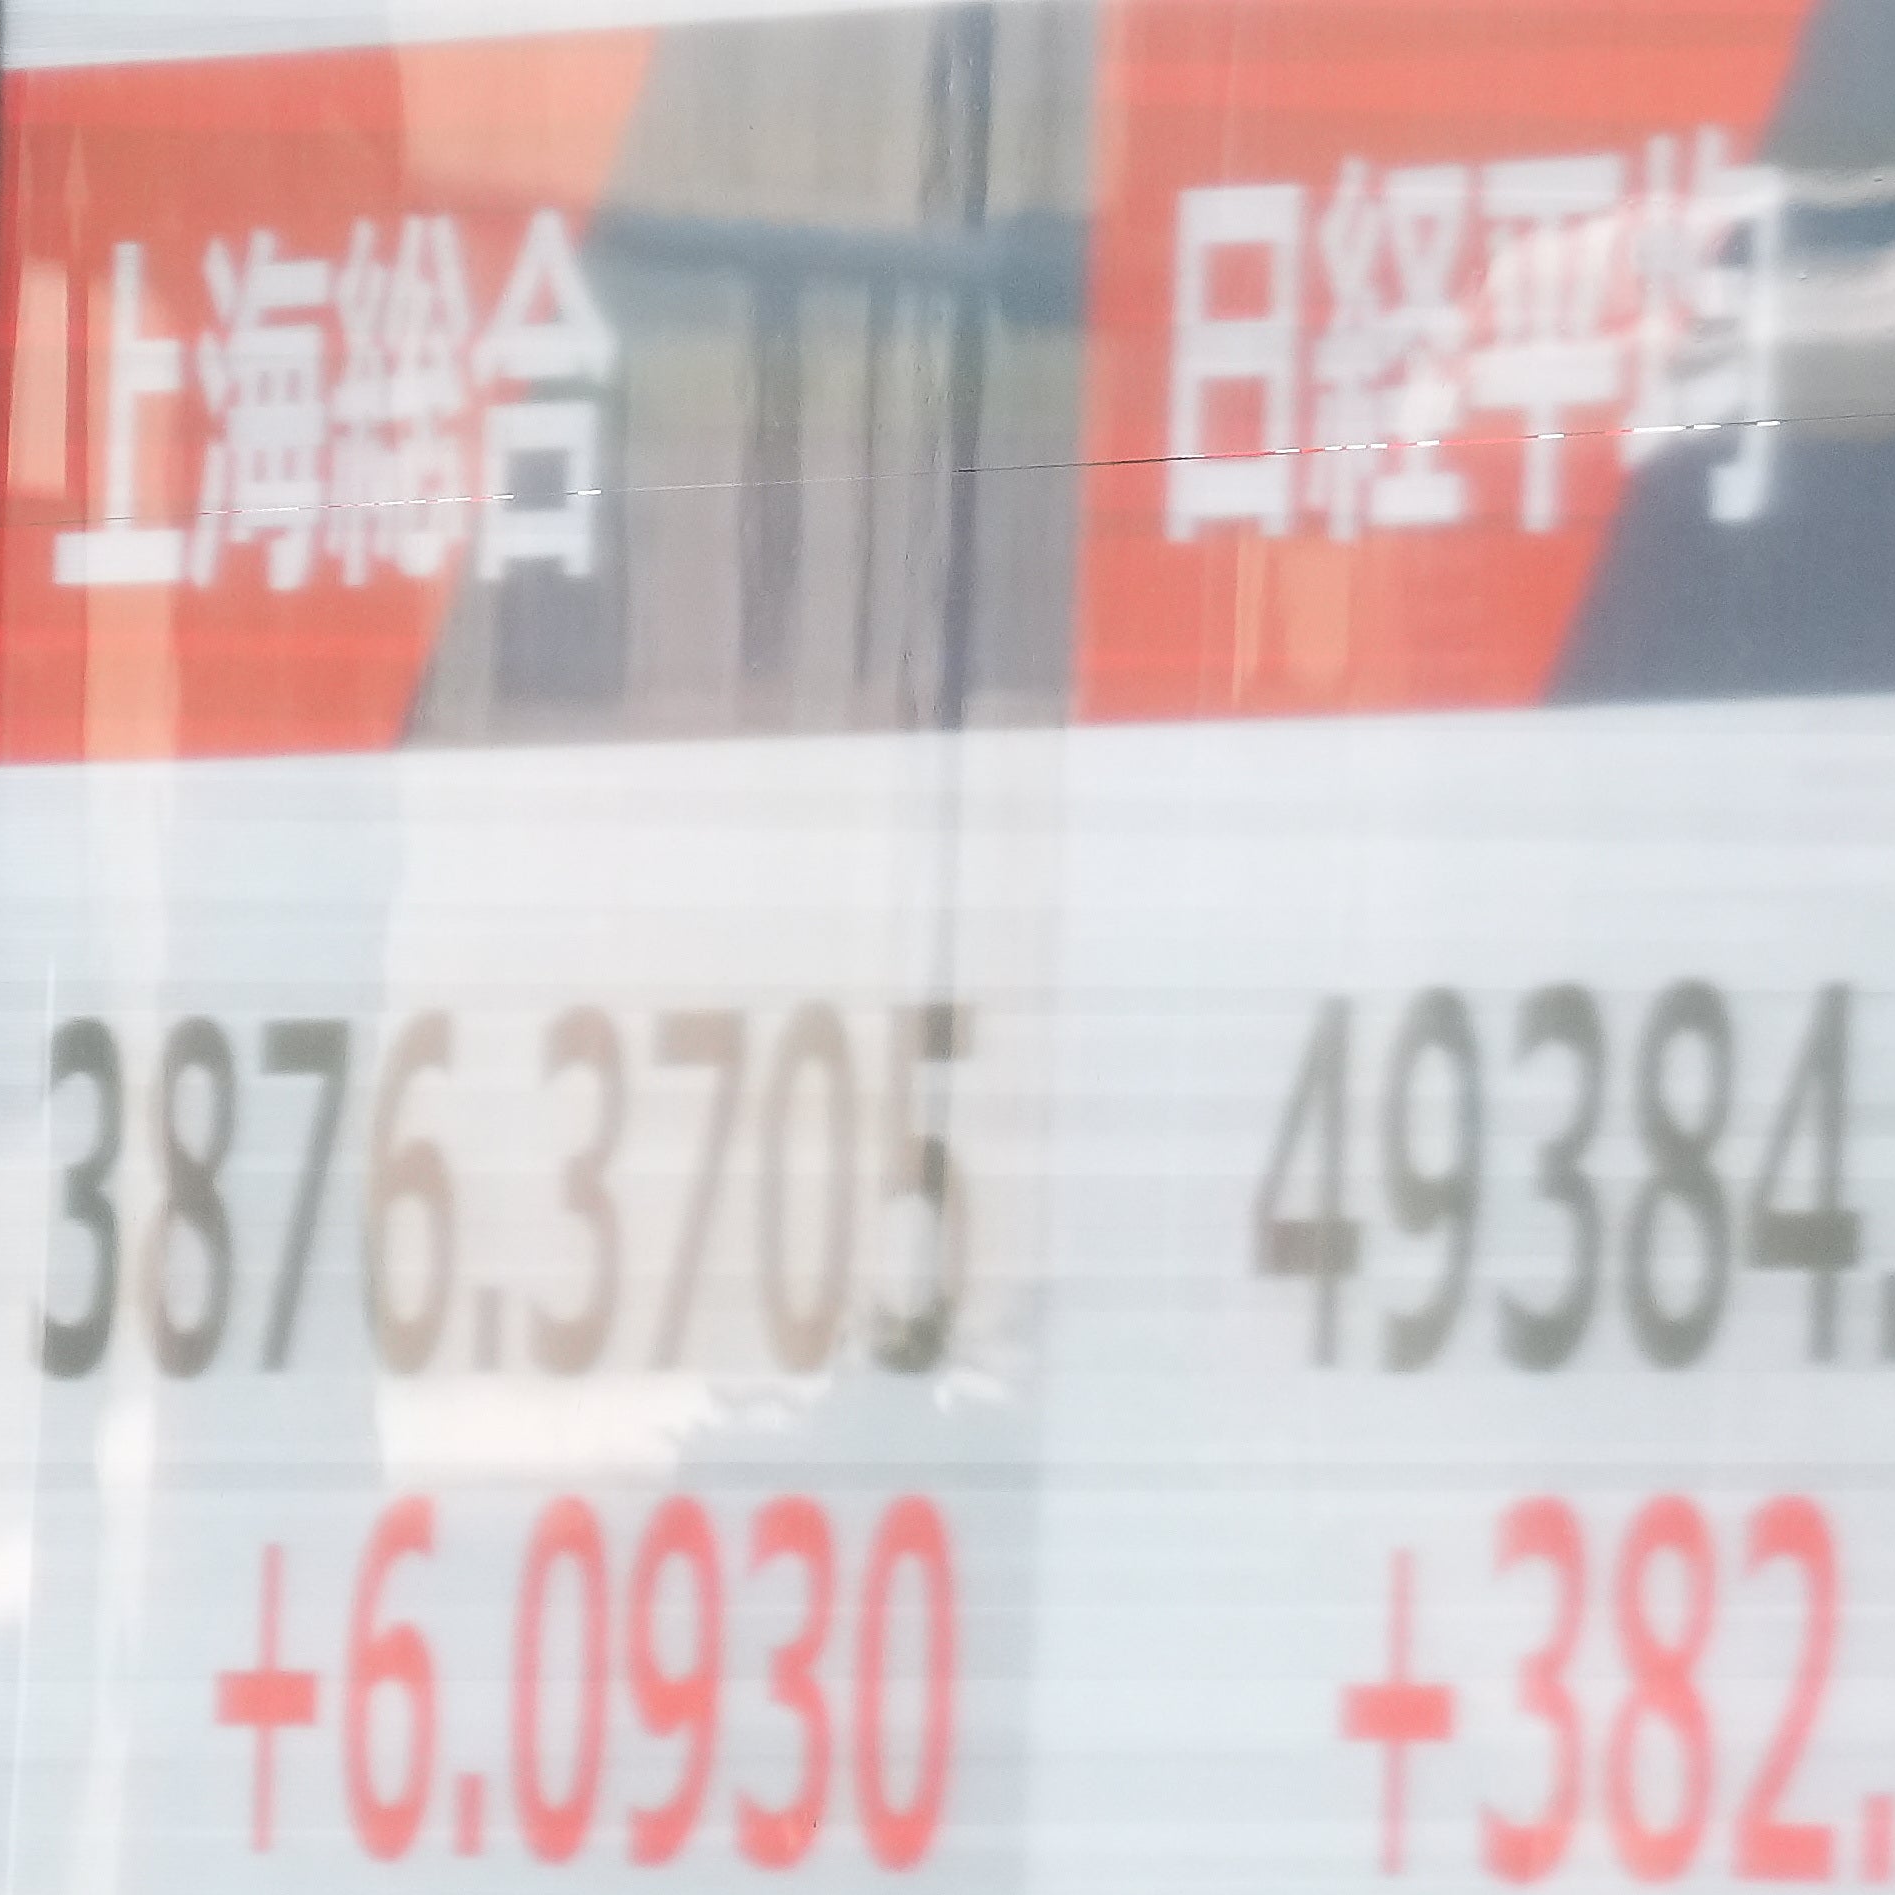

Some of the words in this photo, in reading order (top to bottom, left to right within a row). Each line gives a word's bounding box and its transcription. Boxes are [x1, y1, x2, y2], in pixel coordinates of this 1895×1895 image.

[53, 208, 617, 590] 上海総合
[1165, 127, 1787, 544] 日経平均
[34, 997, 973, 1380] 3876.3705
[214, 1490, 962, 1873] +6.0930
